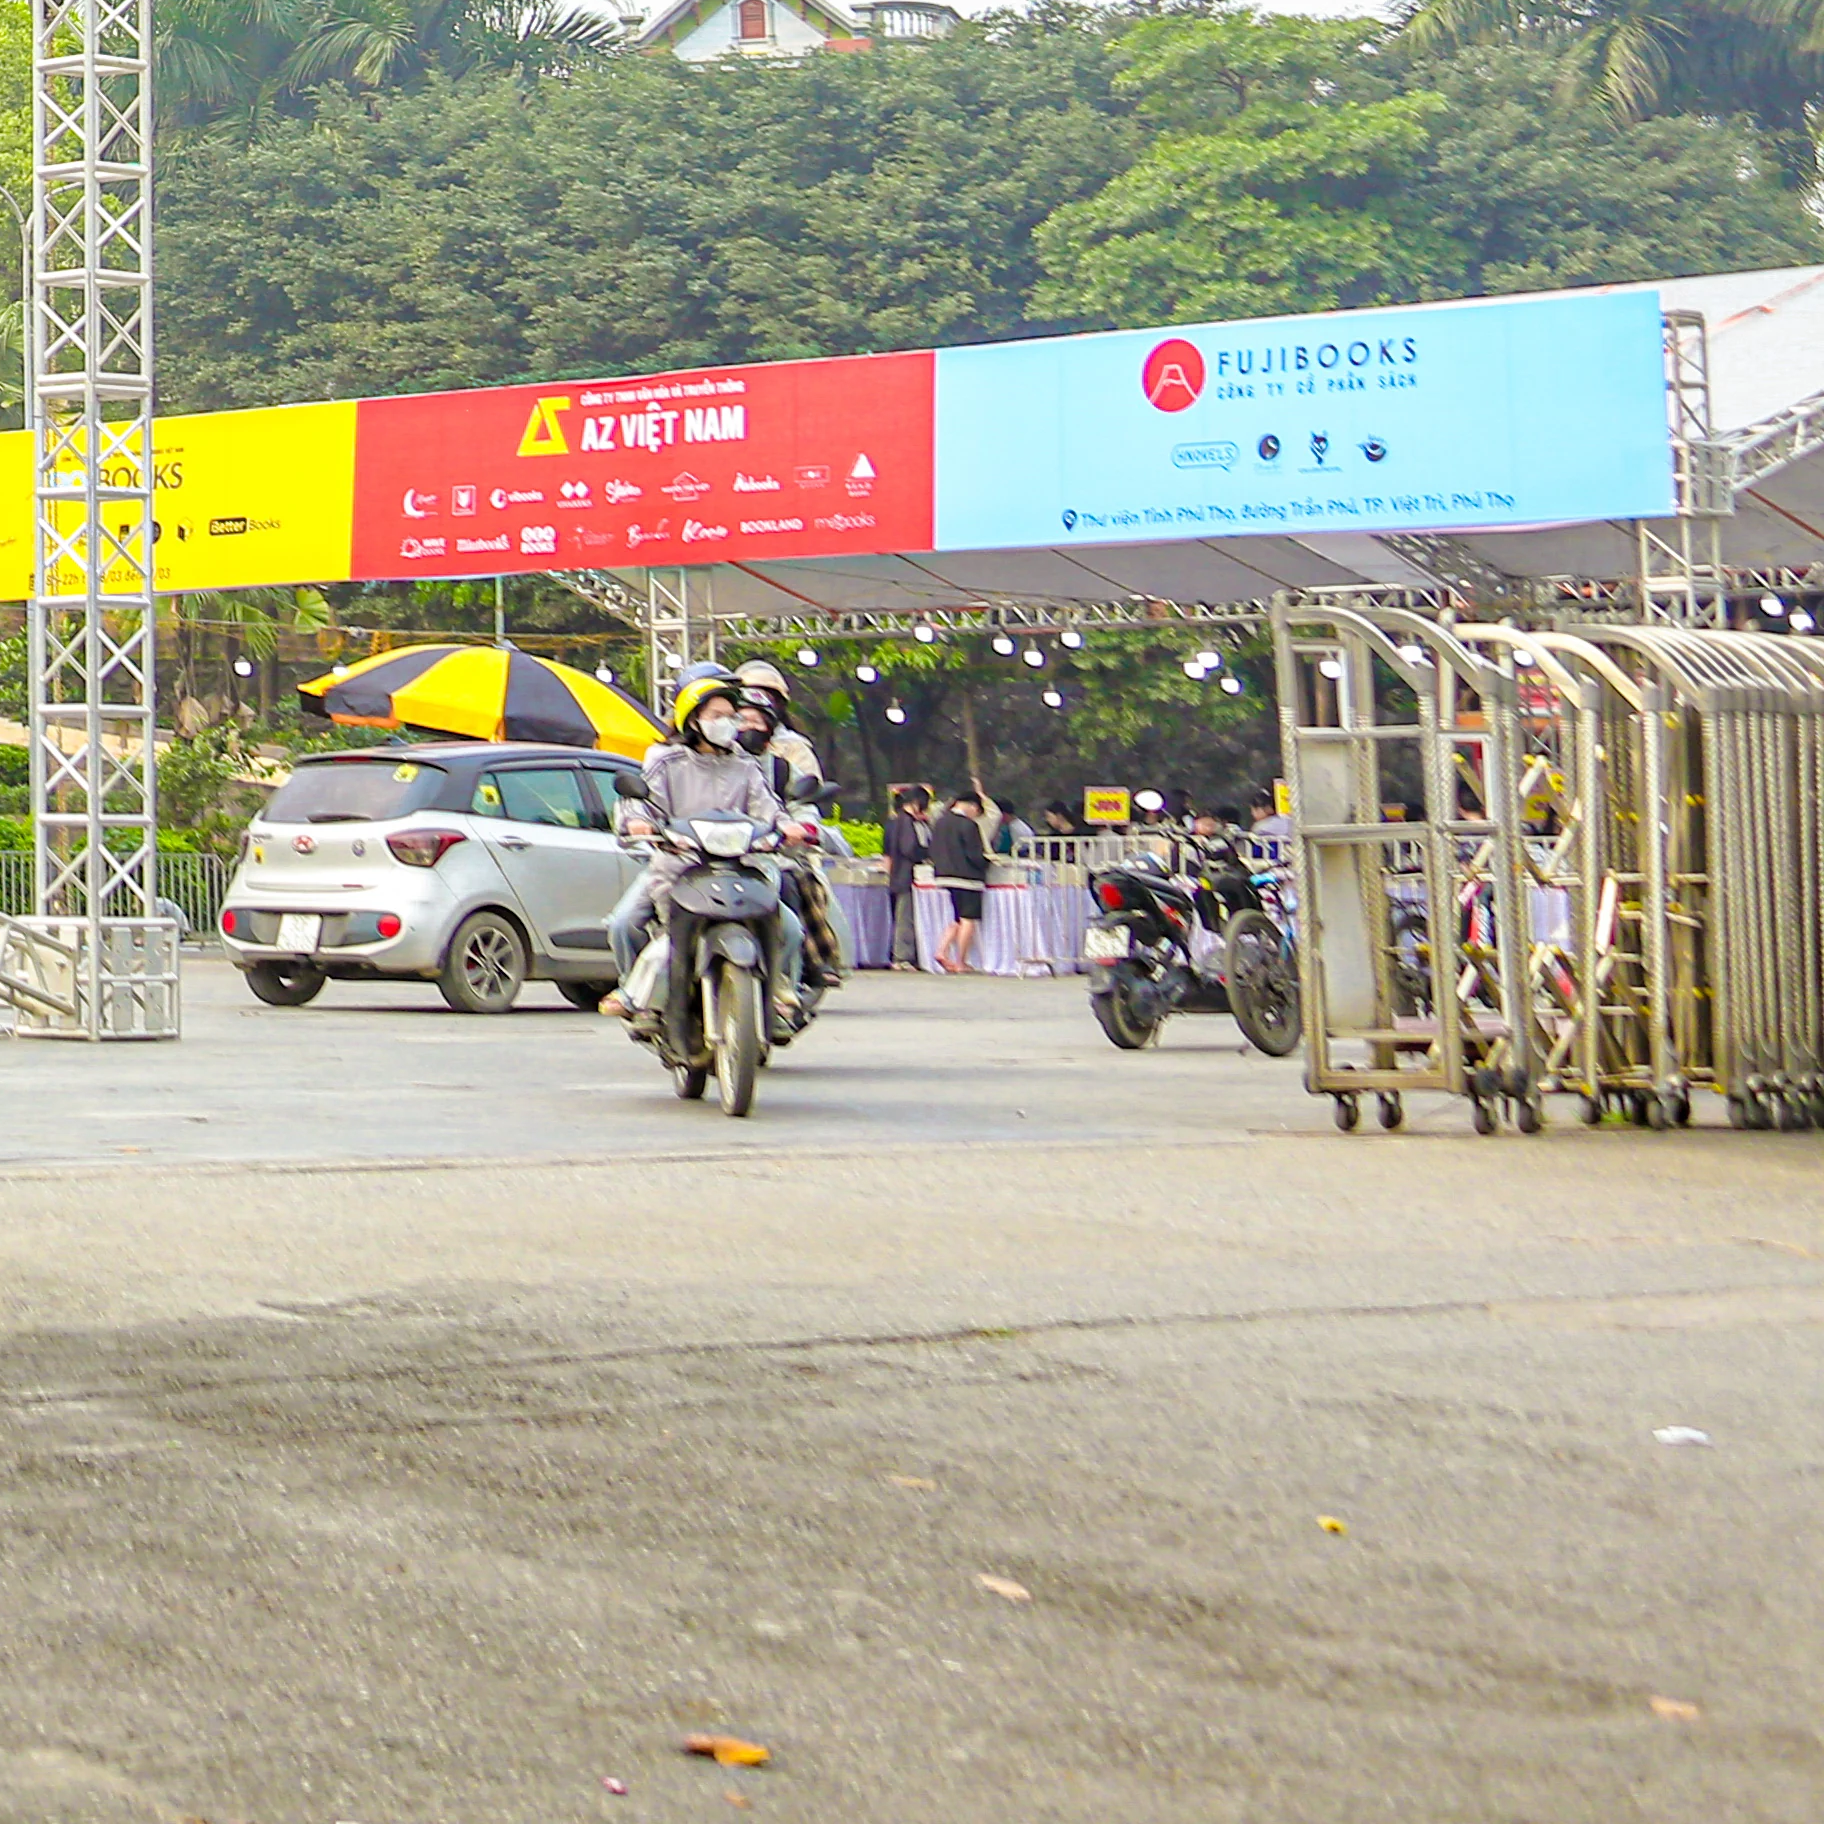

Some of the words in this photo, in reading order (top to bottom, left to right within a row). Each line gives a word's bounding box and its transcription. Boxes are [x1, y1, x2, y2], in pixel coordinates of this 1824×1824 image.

[1217, 337, 1418, 376] FUJIBOOKS
[580, 416, 616, 451] AZ
[620, 401, 680, 453] VIỆT
[684, 405, 745, 443] NAM
